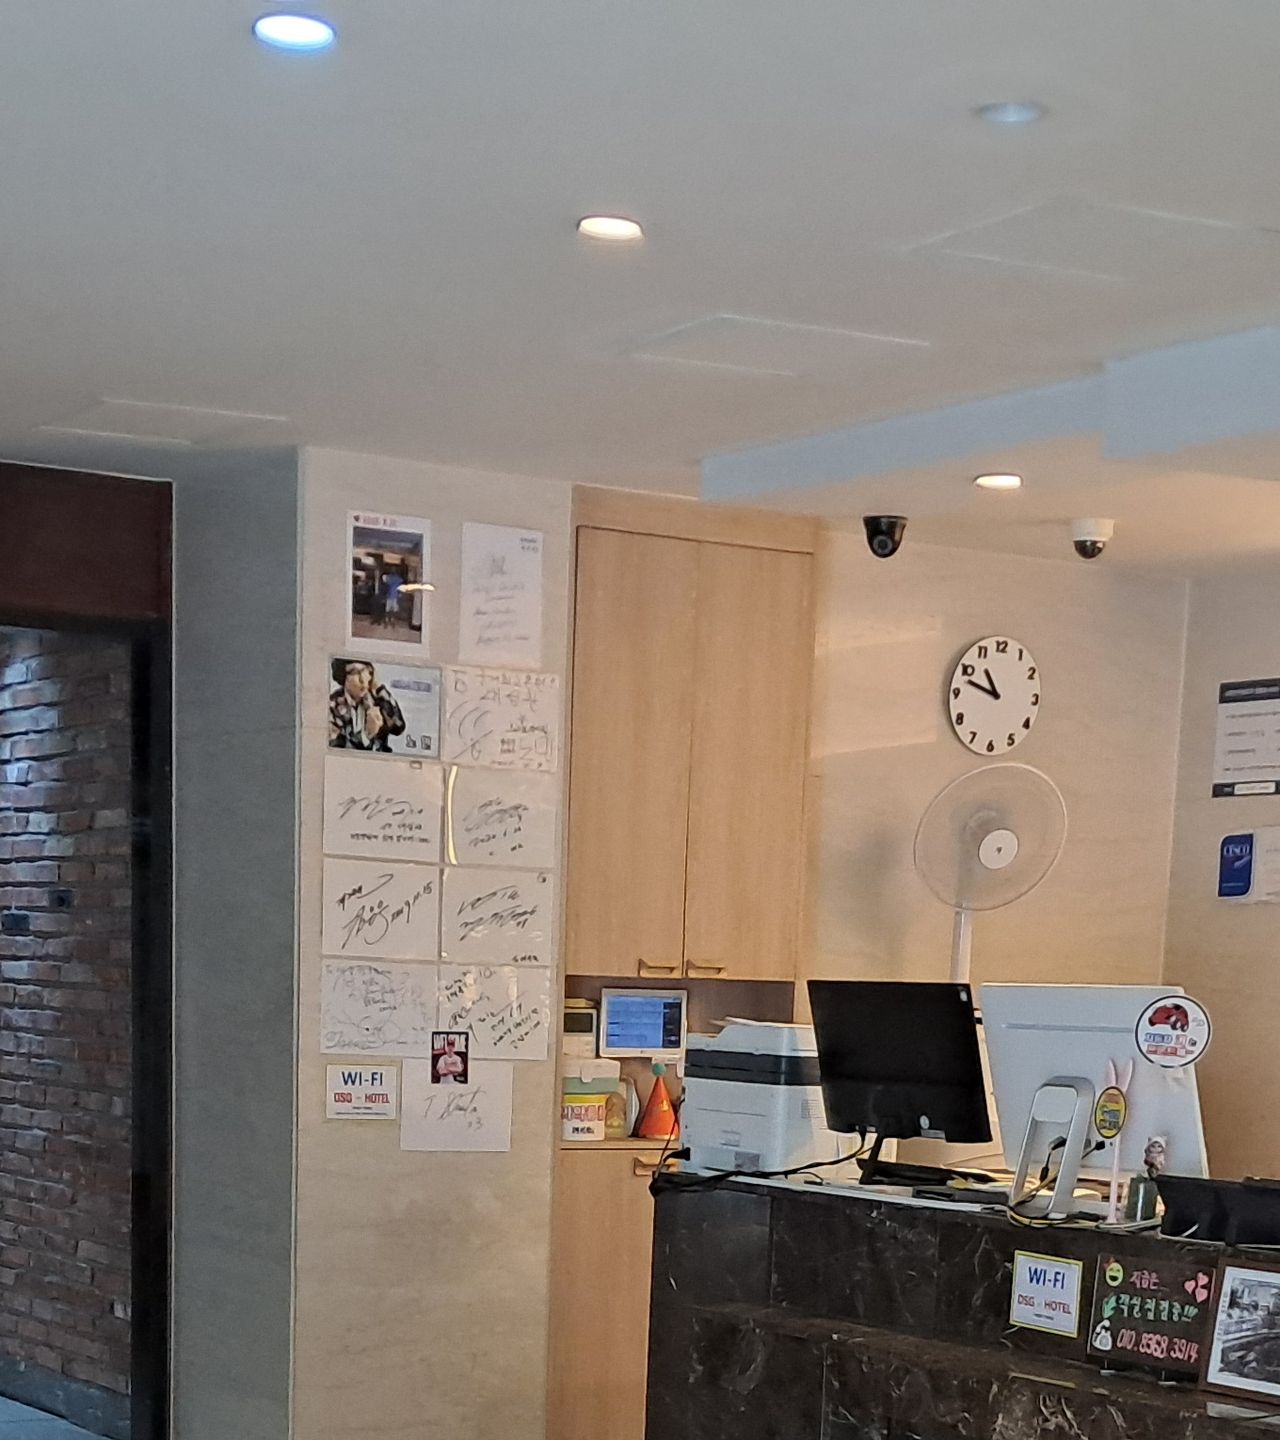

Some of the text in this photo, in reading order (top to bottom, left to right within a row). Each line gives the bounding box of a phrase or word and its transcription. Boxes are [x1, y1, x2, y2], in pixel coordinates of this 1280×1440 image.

[977, 645, 988, 659] 11
[995, 640, 1008, 653] 12
[1018, 648, 1024, 661] 1
[961, 663, 975, 676] 10
[1027, 667, 1036, 680] 2
[952, 687, 961, 699] 9
[1031, 693, 1039, 706] 3
[955, 712, 964, 726] 8
[1022, 717, 1030, 730] 4
[969, 731, 977, 744] 7
[1007, 733, 1015, 747] 5
[986, 740, 995, 752] 6
[341, 1071, 383, 1086] WI-FI
[364, 1092, 391, 1104] HOTEL
[1028, 1266, 1066, 1290] WI-FI
[1017, 1293, 1072, 1315] DSG HOTEL
